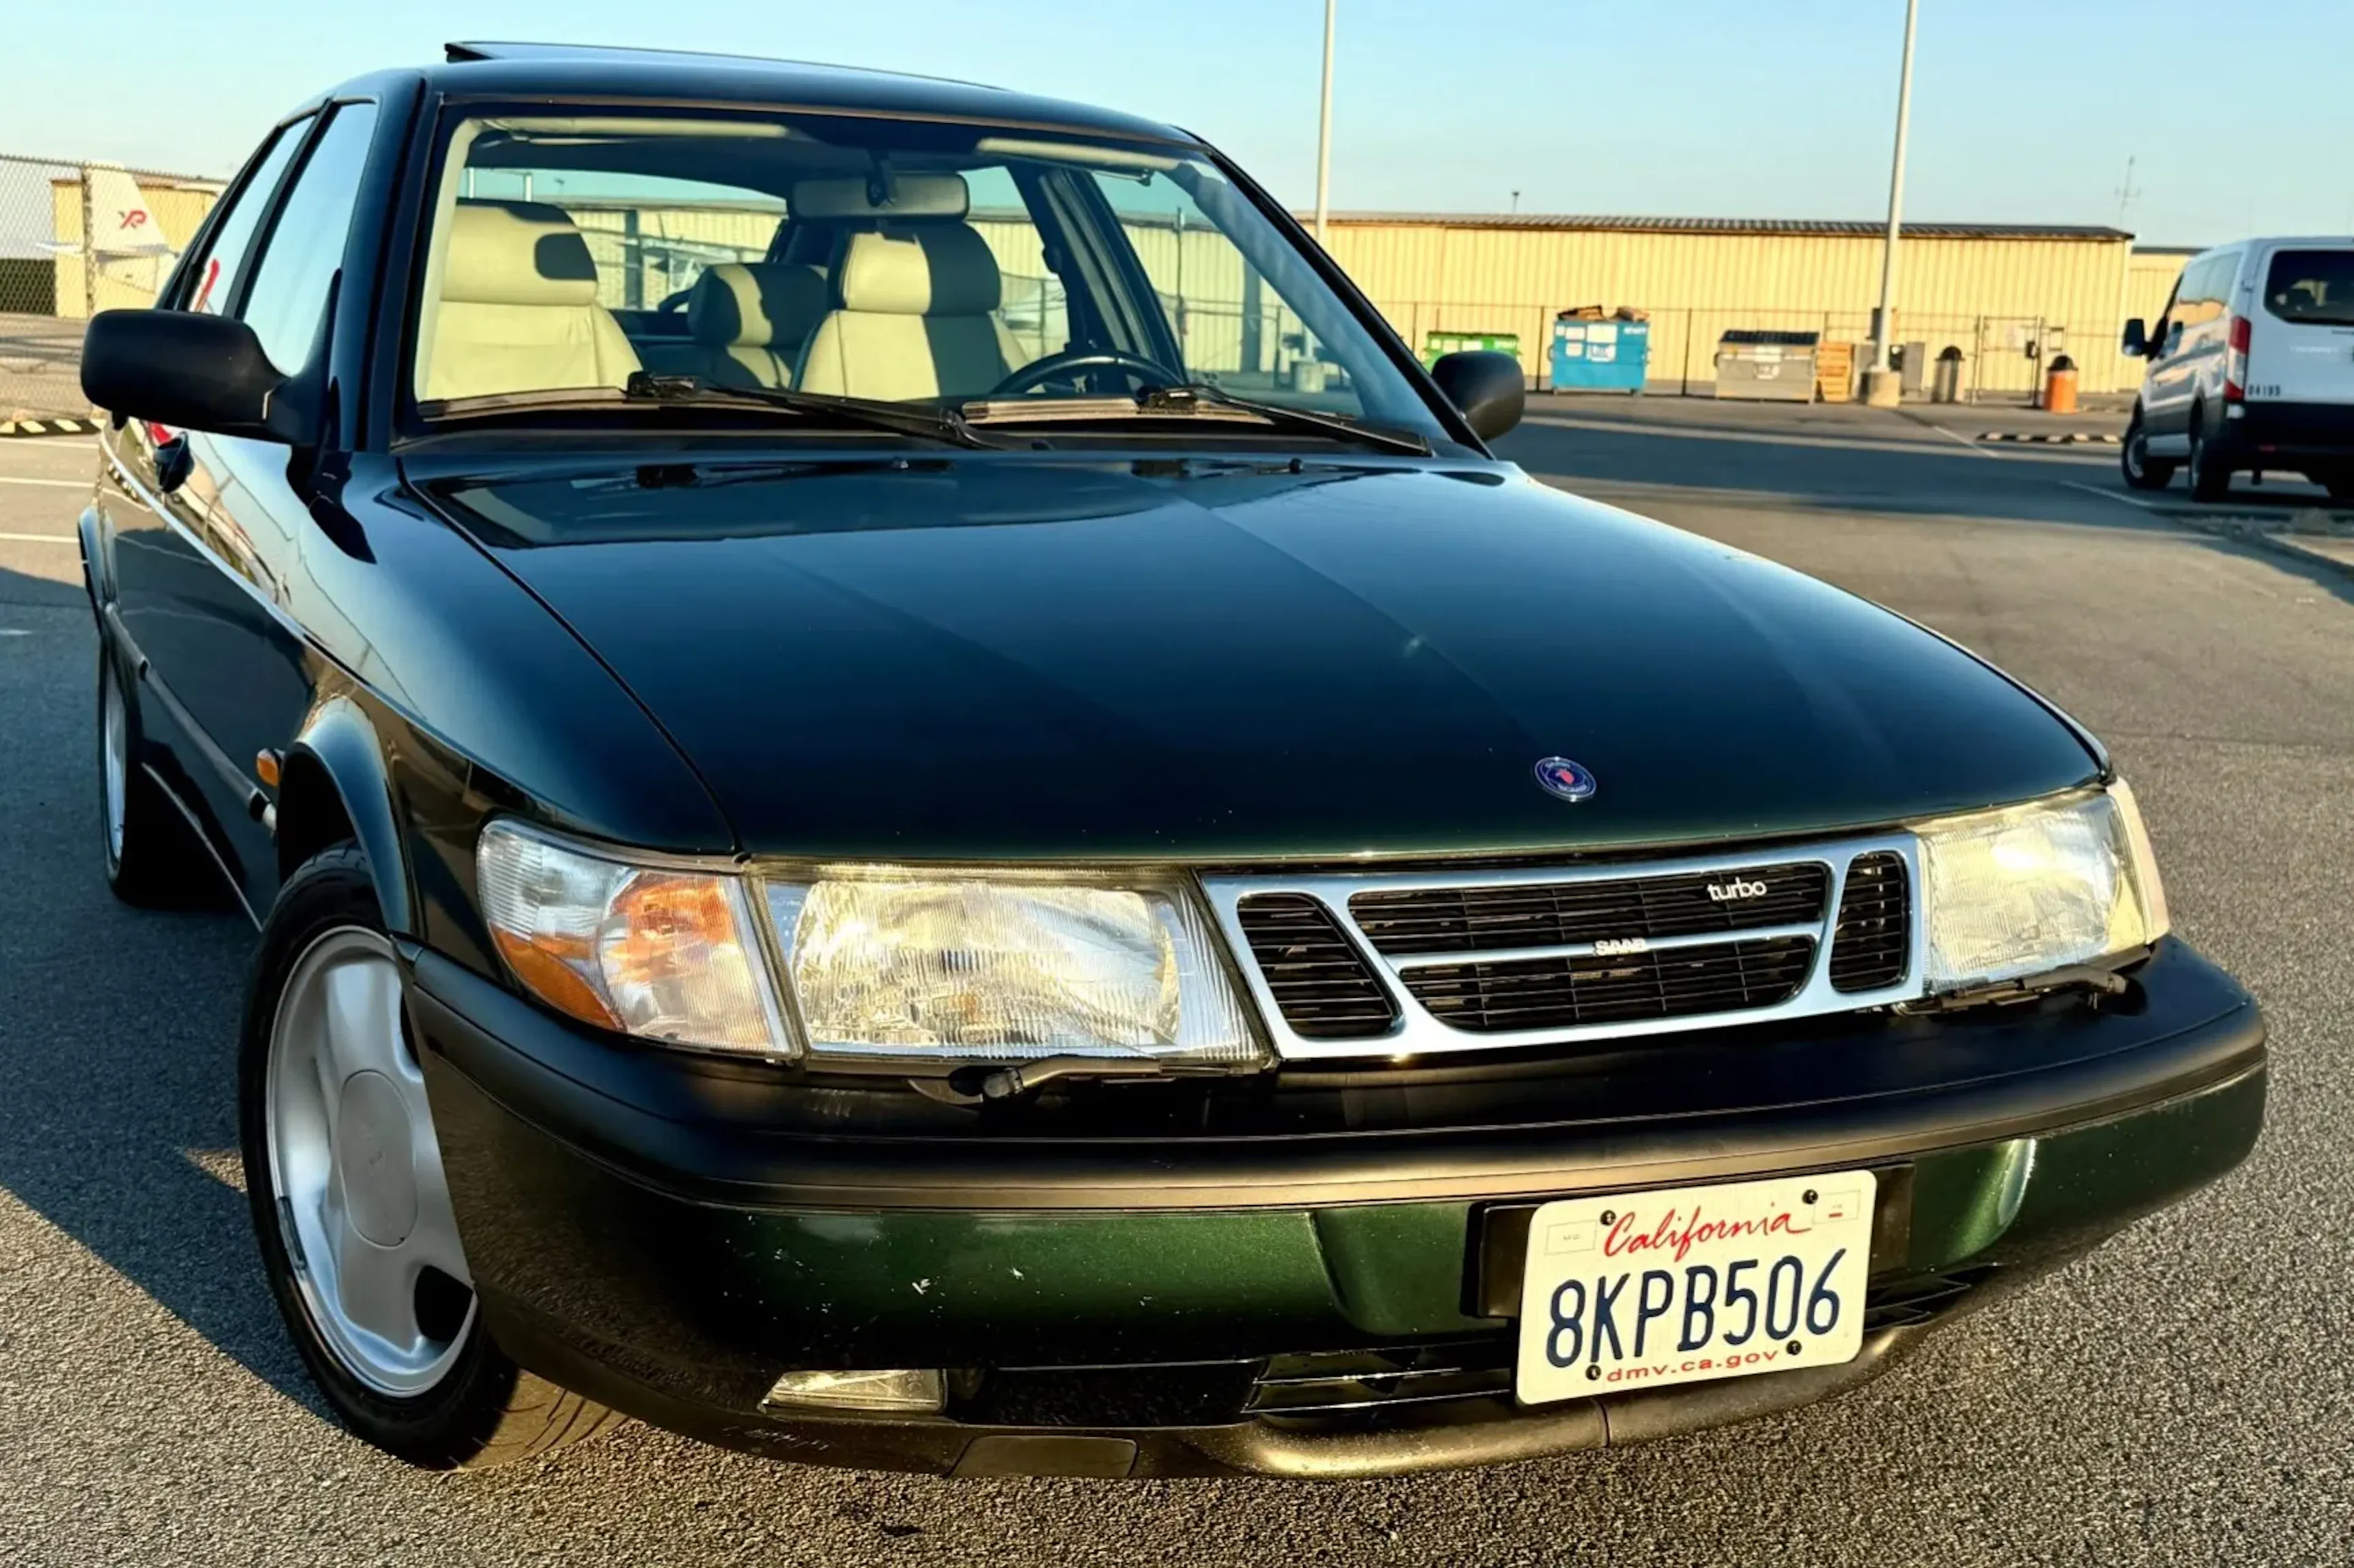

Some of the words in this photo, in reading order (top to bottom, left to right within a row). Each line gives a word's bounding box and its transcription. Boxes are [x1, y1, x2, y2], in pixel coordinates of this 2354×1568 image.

[1707, 877, 1767, 901] turbo
[1594, 937, 1647, 956] SAAB
[1603, 1202, 1813, 1263] California
[1546, 1248, 1846, 1368] 8KPB506
[1606, 1350, 1778, 1382] dmv.ca.gov
